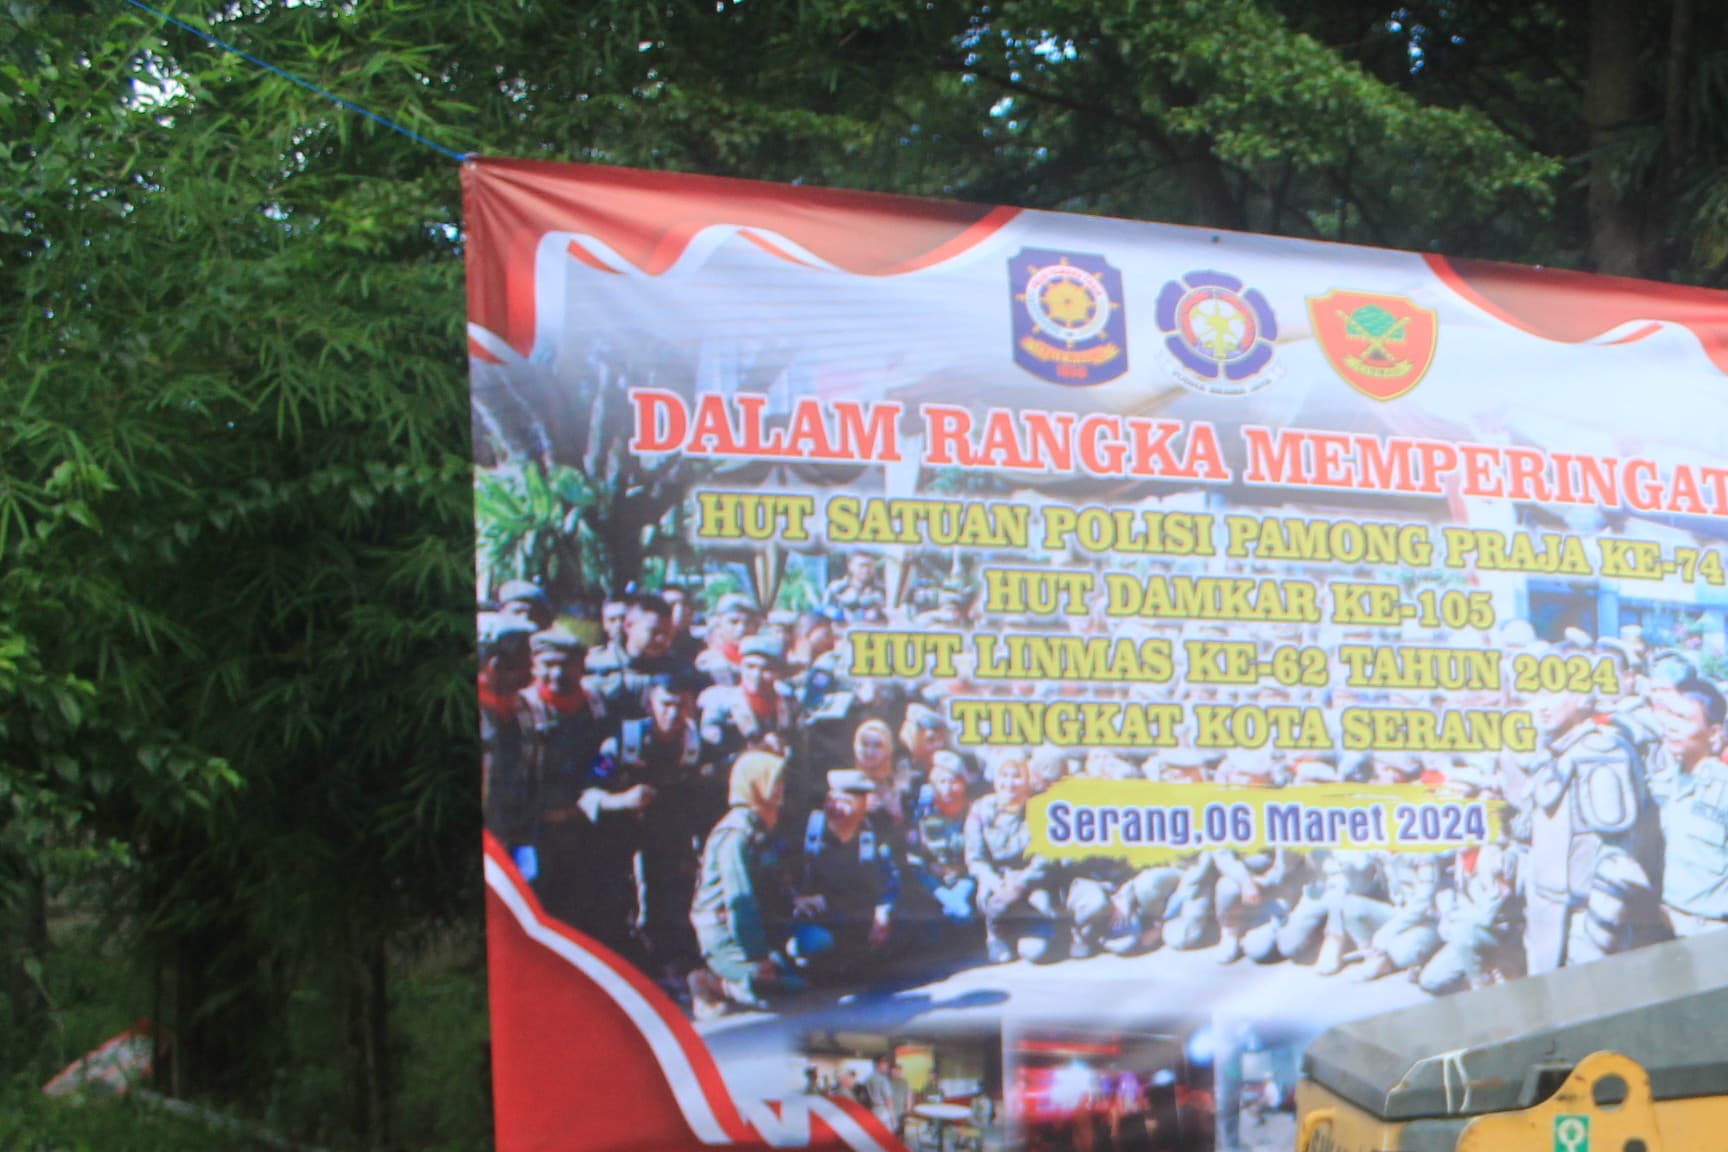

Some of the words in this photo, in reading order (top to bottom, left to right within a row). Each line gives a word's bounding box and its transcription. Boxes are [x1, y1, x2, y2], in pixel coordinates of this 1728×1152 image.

[630, 392, 901, 461] DALAM
[923, 405, 1230, 480] RANGKA
[699, 492, 813, 540] HUT
[827, 497, 1030, 548] SATUAN
[1042, 506, 1215, 556] POLISI
[1227, 516, 1432, 566] PAMONG
[1444, 527, 1592, 575] PRAJA
[1598, 539, 1725, 585] KE-74
[985, 570, 1093, 615] HUT
[1105, 573, 1321, 622] DAMKAR
[1331, 584, 1495, 630] KE-105
[849, 632, 961, 678] HUT
[974, 635, 1174, 682] LINMAS
[1185, 640, 1328, 687] KE-62
[1340, 645, 1501, 690] TAHUN
[1514, 654, 1619, 694] 2024
[953, 701, 1183, 746] TINGKAT
[1194, 705, 1333, 749] KOTA
[1342, 707, 1537, 752] SERANG
[1267, 804, 1384, 841] Maret
[1398, 804, 1486, 841] 2024
